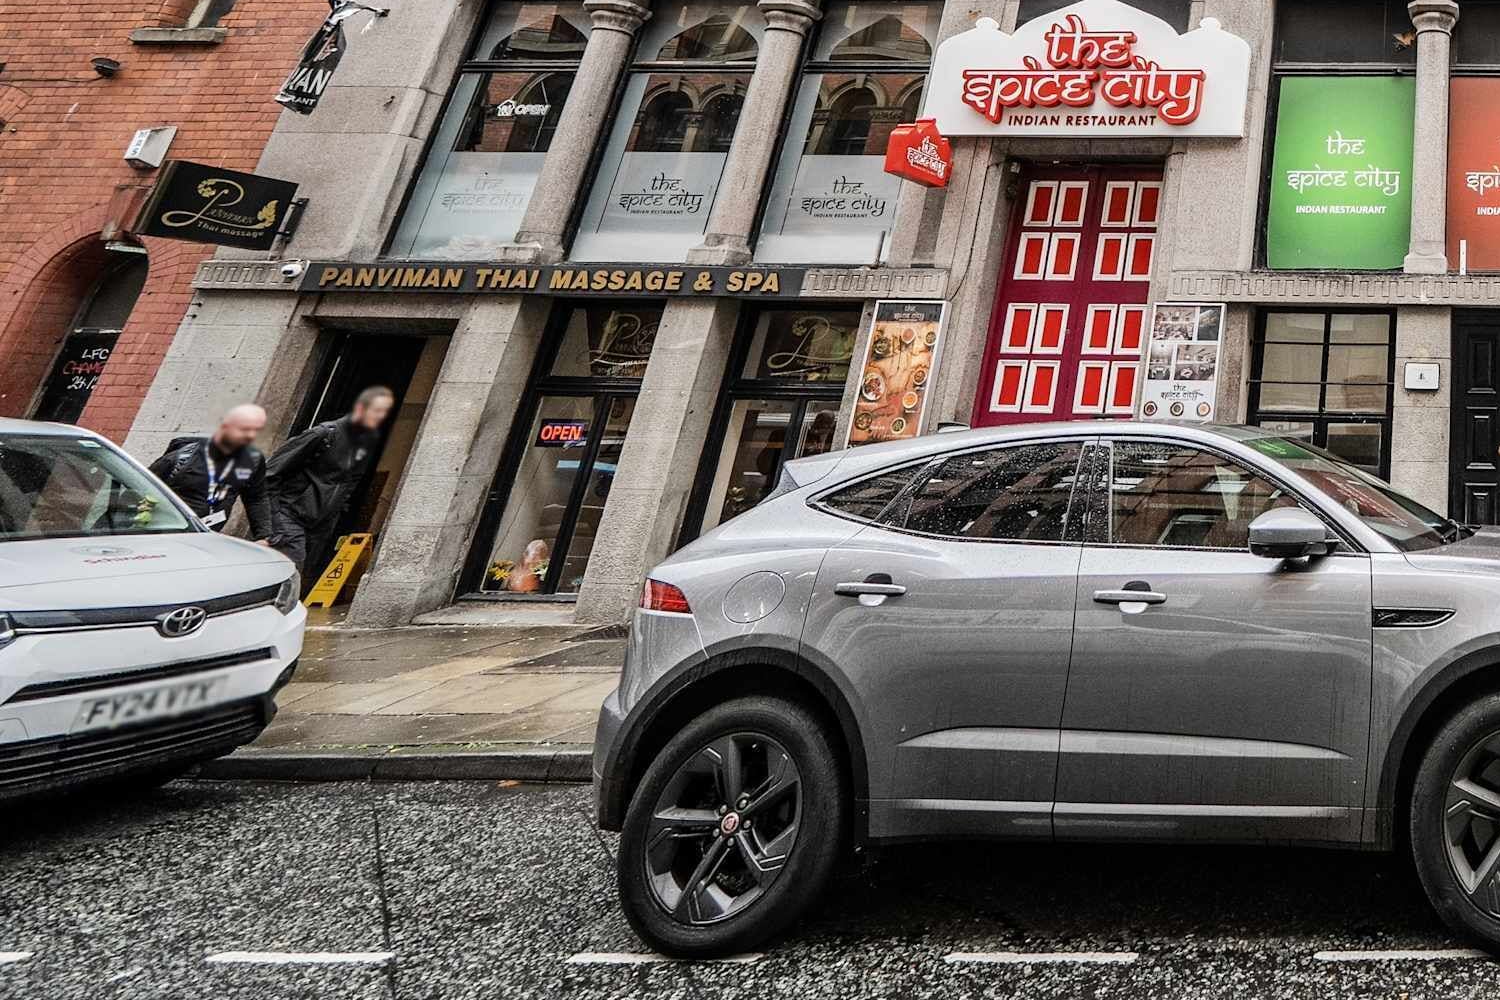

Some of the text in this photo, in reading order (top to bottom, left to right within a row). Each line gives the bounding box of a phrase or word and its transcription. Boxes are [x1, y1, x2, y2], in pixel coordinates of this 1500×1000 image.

[1045, 14, 1138, 69] the
[961, 56, 1207, 125] spice city
[514, 104, 551, 116] OPEN
[1008, 115, 1157, 127] INDIAN RESTAURANT
[1326, 130, 1366, 155] the
[651, 171, 683, 191] the
[832, 175, 865, 194] the
[1286, 163, 1401, 197] spice city
[619, 188, 704, 214] spice city
[801, 191, 887, 217] spice city
[1295, 205, 1387, 214] INDIAN RESTAURANT
[319, 267, 780, 293] PANVIMAN THAI MASSAGE & SPA
[81, 347, 109, 360] LFC
[540, 424, 582, 442] OPEN
